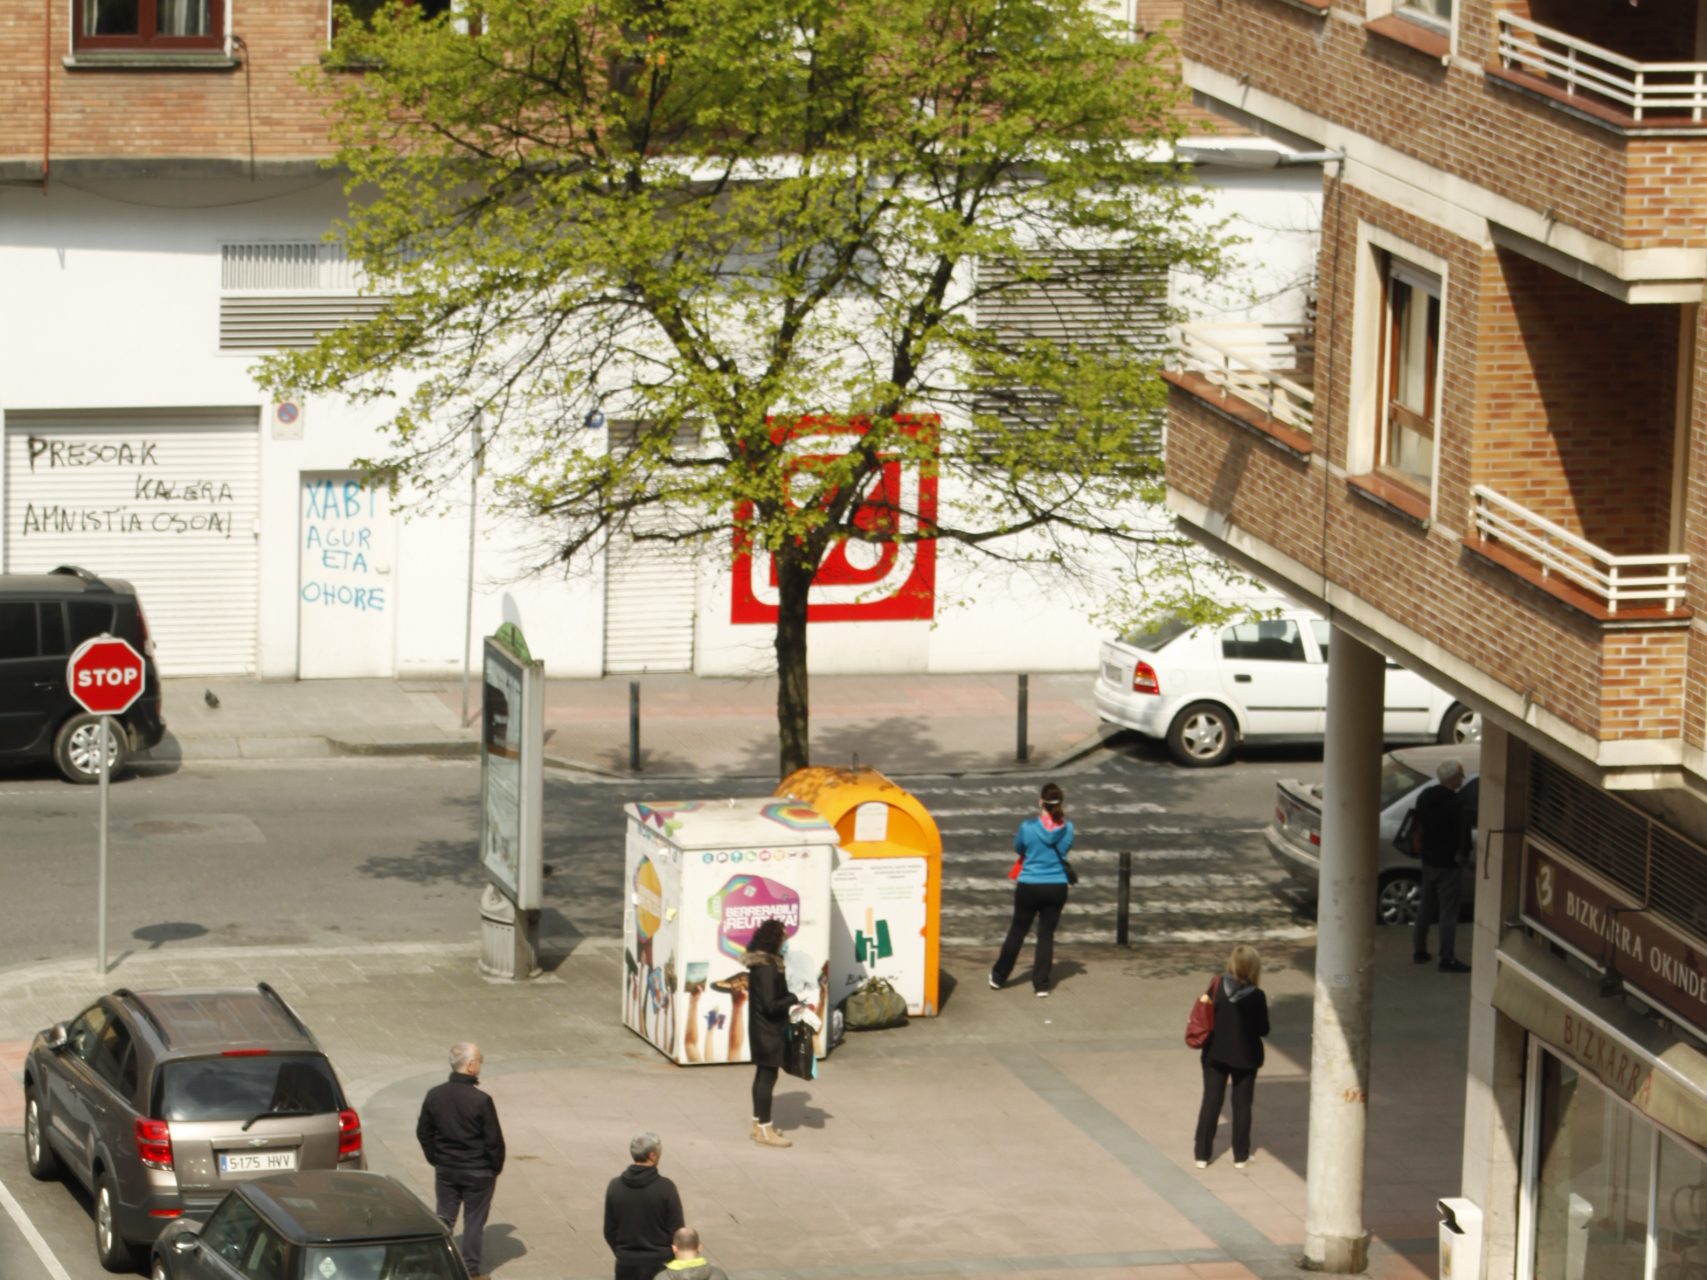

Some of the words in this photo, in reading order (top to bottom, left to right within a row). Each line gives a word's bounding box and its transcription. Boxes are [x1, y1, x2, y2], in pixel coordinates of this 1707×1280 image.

[28, 434, 158, 474] PRESOAK
[306, 479, 374, 520] XABI
[152, 510, 231, 539] OSOA!
[306, 525, 372, 550] AGUR
[322, 549, 367, 573] ETA
[302, 581, 385, 611] OHORE
[77, 666, 138, 688] STOP
[1566, 890, 1643, 962] BIZKARRA
[1564, 1013, 1653, 1105] BIZKARRA
[229, 1157, 261, 1170] 5175
